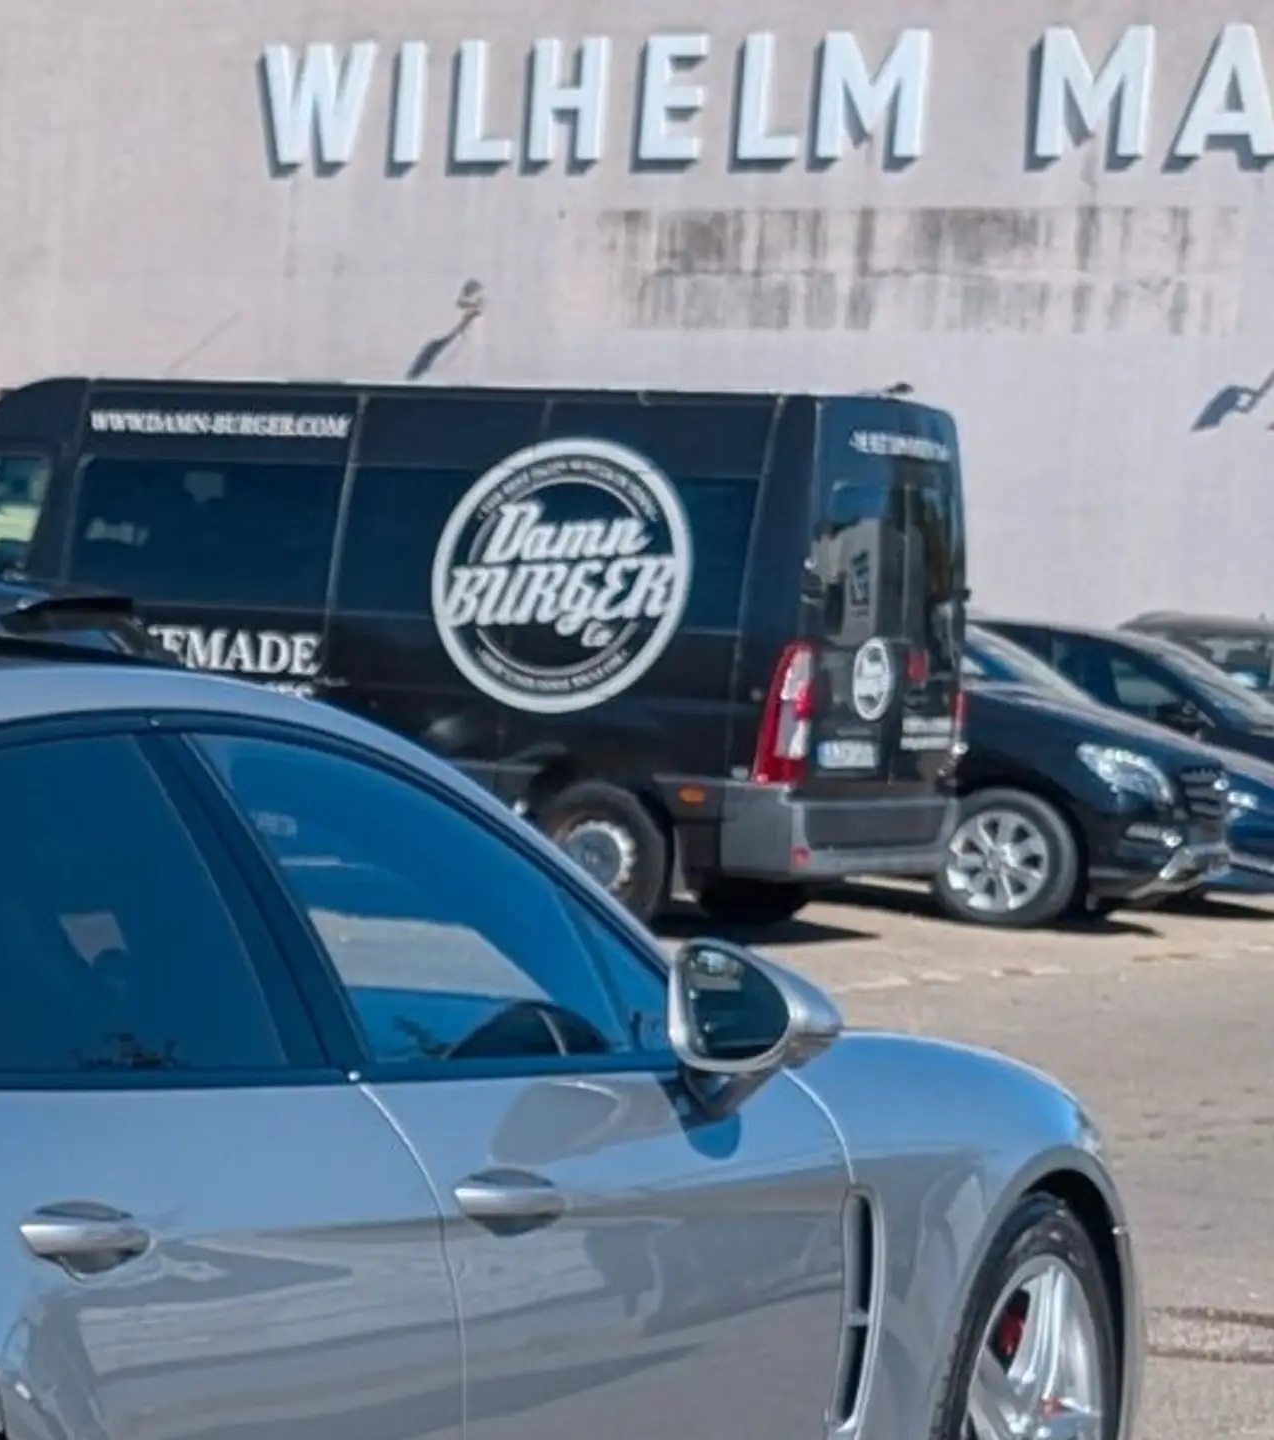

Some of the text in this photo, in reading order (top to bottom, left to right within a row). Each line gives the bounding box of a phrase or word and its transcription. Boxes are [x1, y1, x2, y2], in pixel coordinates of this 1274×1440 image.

[259, 27, 933, 172] WILHELM
[481, 500, 654, 565] Damn
[447, 558, 676, 637] BURGER
